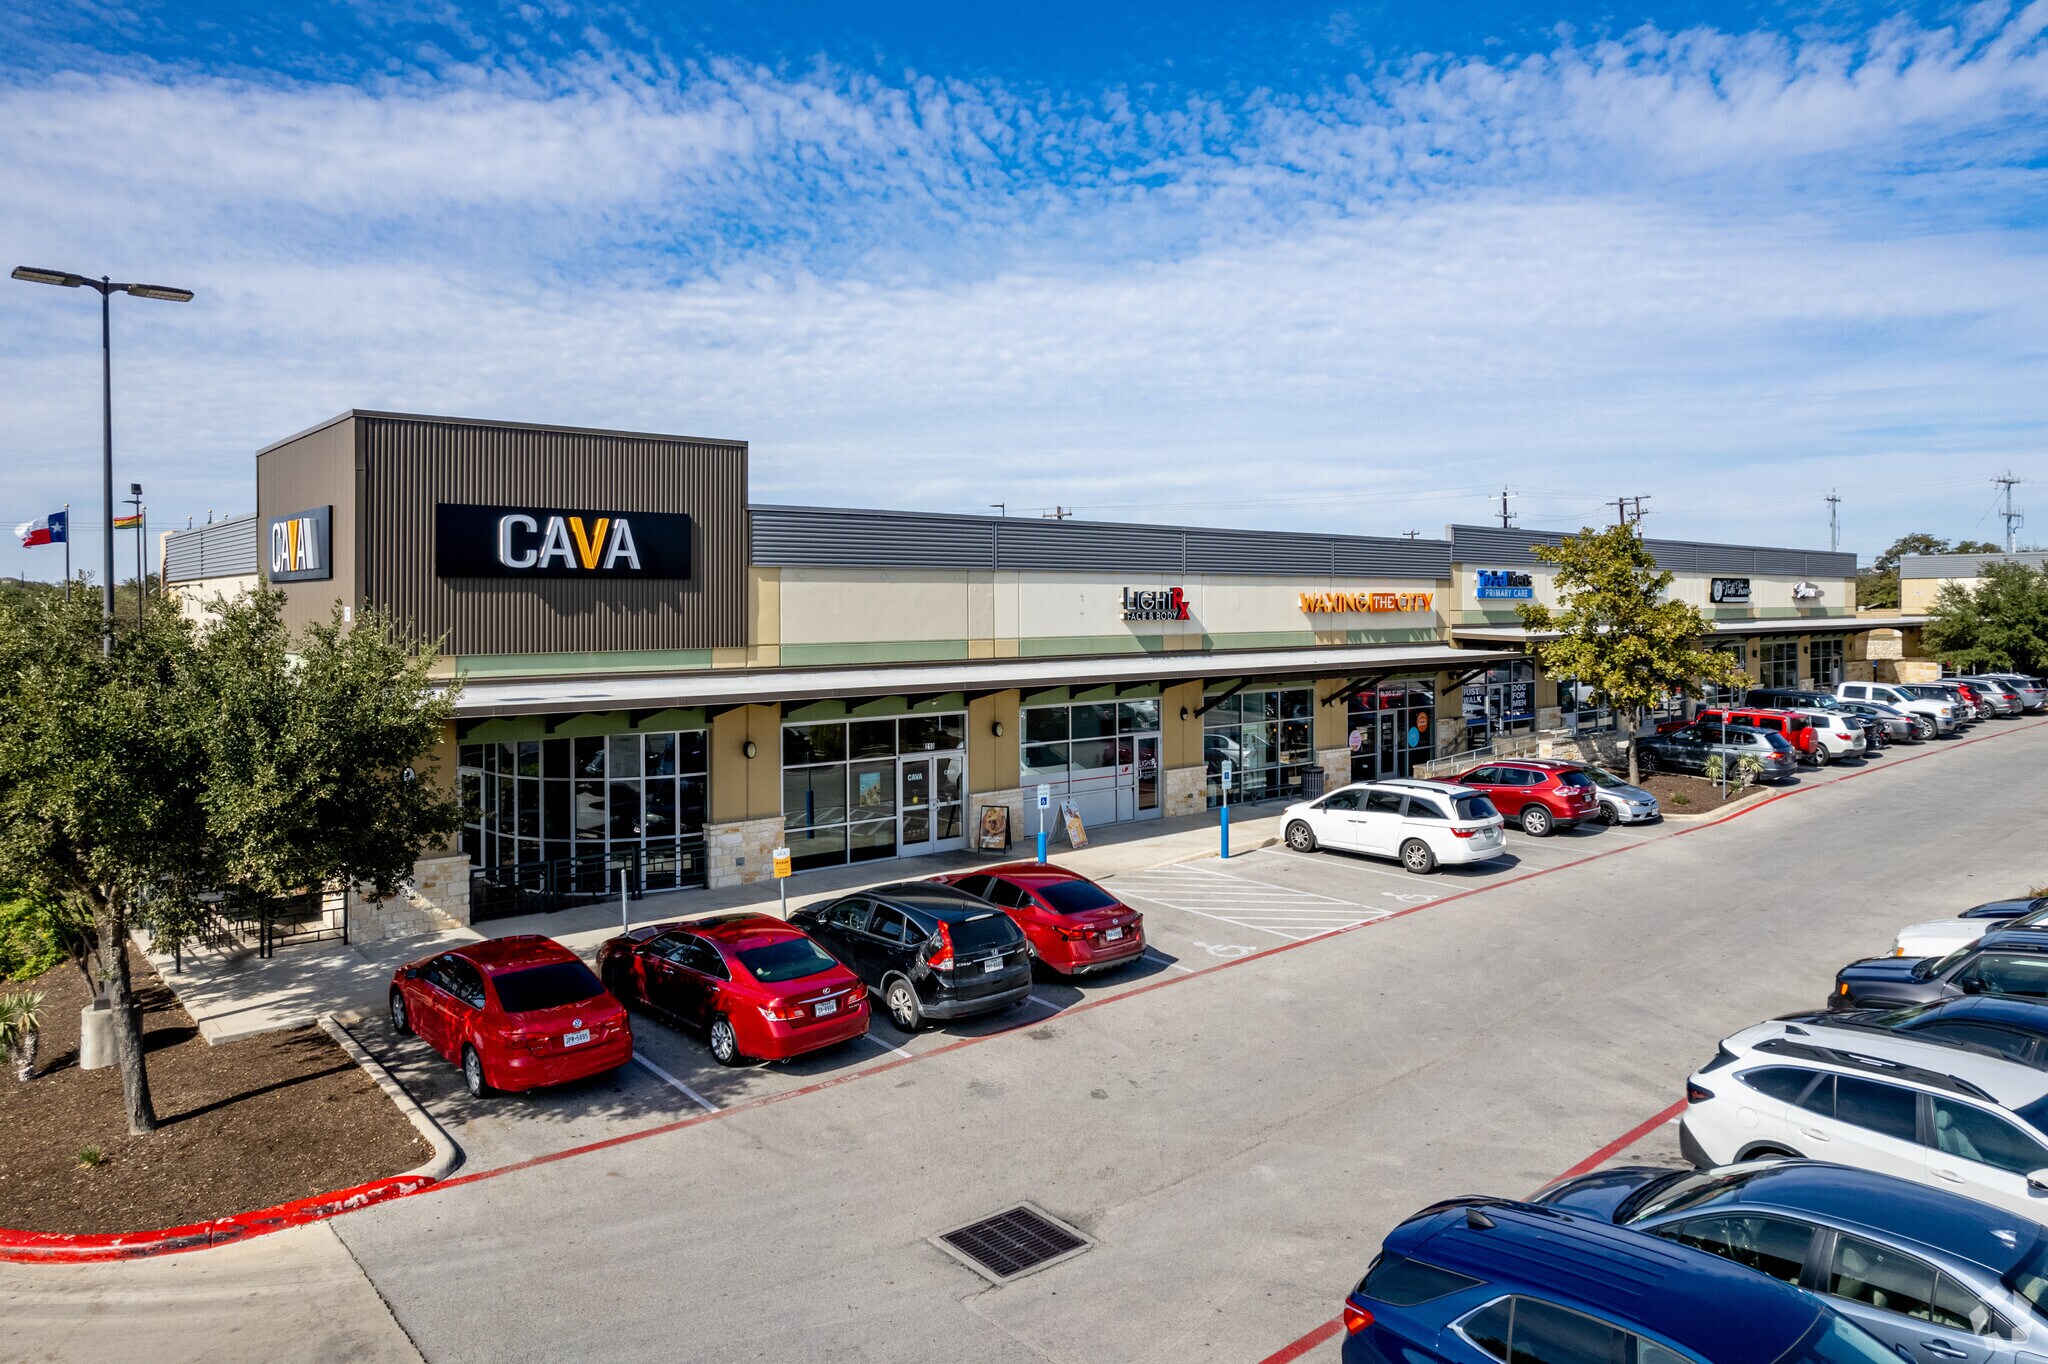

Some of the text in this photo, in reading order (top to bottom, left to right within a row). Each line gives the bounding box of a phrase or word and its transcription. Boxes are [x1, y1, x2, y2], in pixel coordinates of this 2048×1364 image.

[272, 518, 315, 573] CAVA
[498, 514, 641, 570] CAVA
[1485, 589, 1528, 598] PRIMARY CARE
[1299, 592, 1433, 612] WAXING THE CITY
[1127, 611, 1177, 620] FACE & BODY
[1463, 687, 1480, 696] JUST
[1512, 684, 1526, 692] DOC
[1512, 691, 1525, 699] FOR
[1512, 699, 1526, 707] MEN
[907, 773, 923, 781] CAVA
